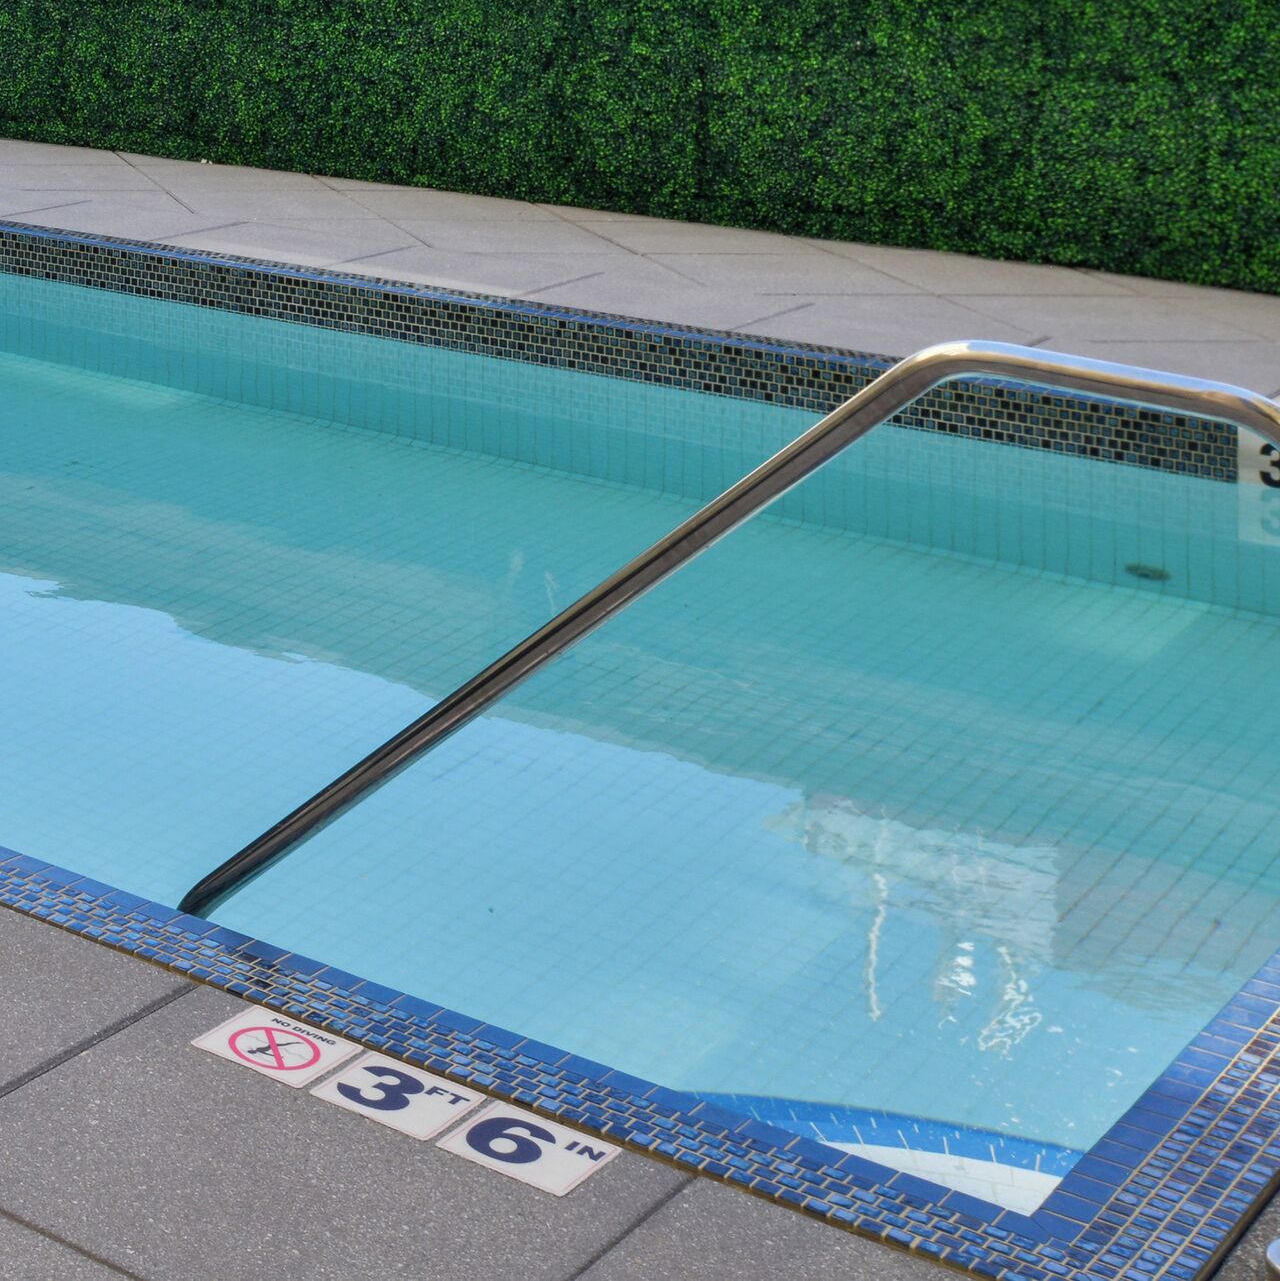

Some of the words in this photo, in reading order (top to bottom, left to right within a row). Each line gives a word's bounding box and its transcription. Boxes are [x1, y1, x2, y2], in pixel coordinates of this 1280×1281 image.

[271, 1017, 291, 1027] NO
[292, 1026, 337, 1045] DIVING
[336, 1065, 424, 1111] 3
[423, 1086, 471, 1108] FT
[466, 1116, 556, 1164] 6
[564, 1140, 607, 1162] IN
